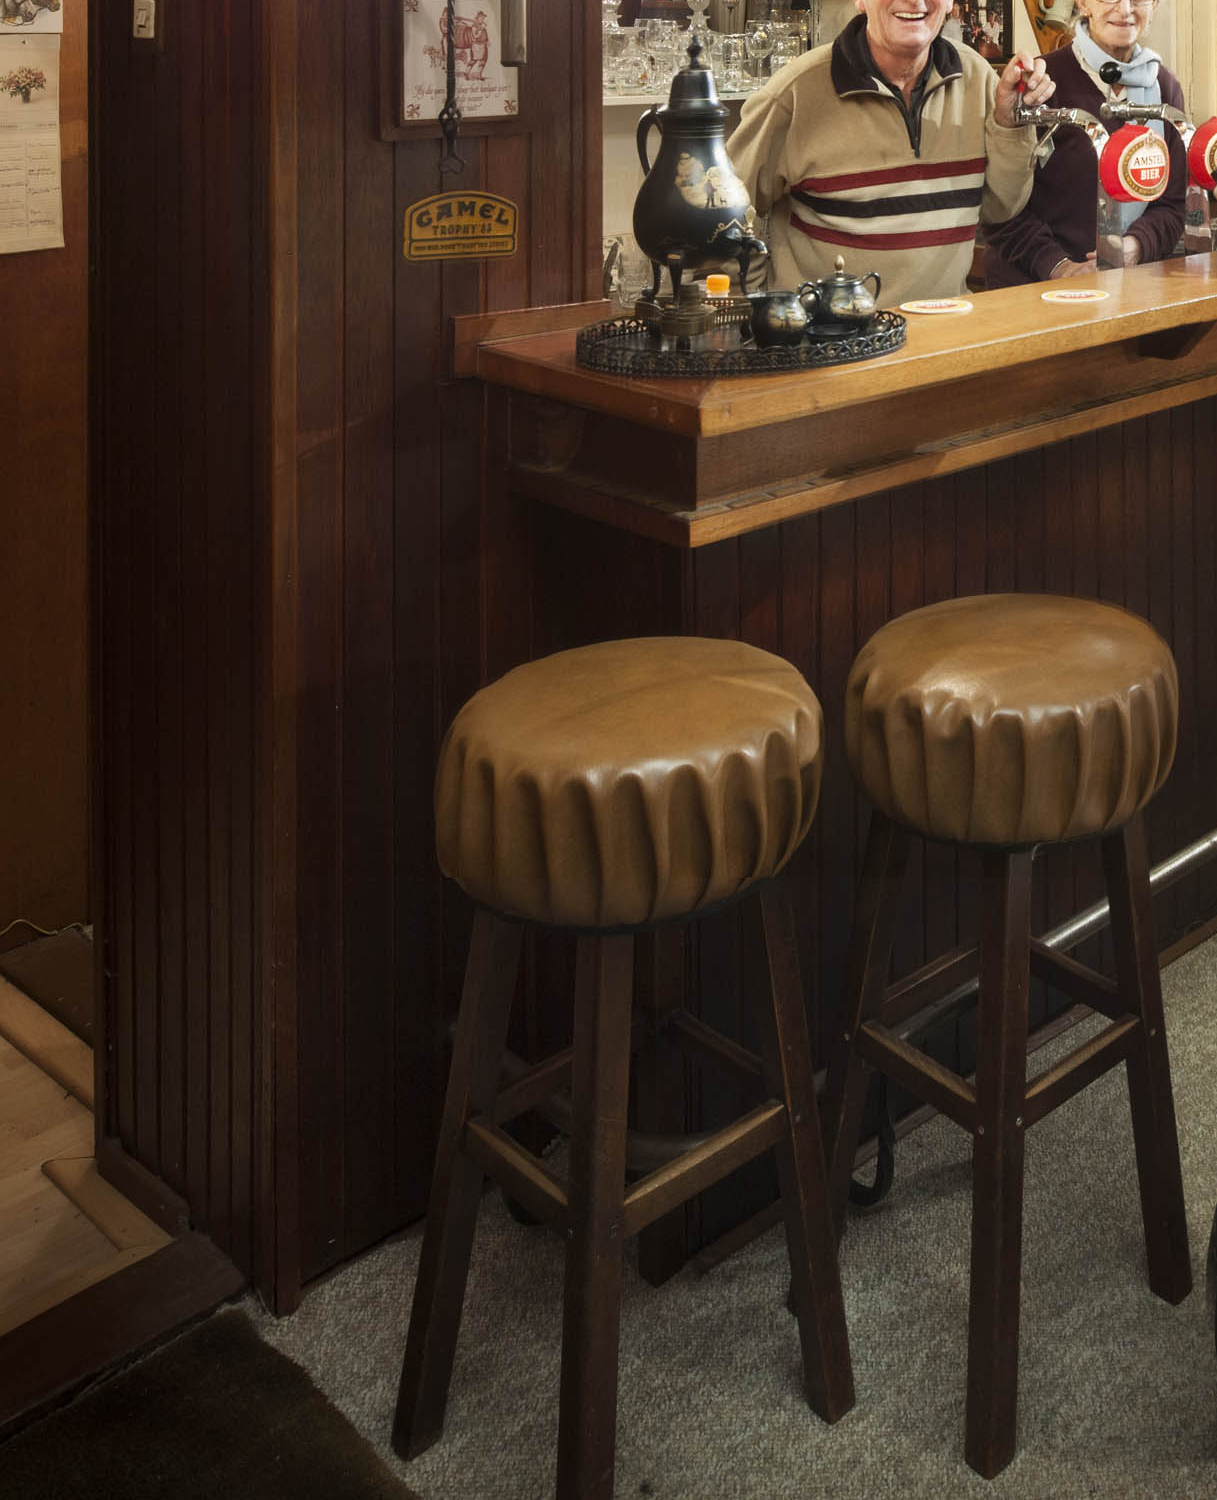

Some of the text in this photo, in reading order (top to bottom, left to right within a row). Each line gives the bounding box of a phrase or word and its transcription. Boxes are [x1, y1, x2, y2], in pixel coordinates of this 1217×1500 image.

[1133, 155, 1164, 167] AMSTEL
[1140, 167, 1161, 181] BIER
[415, 200, 510, 228] CAMEL
[432, 223, 475, 236] TROPHY
